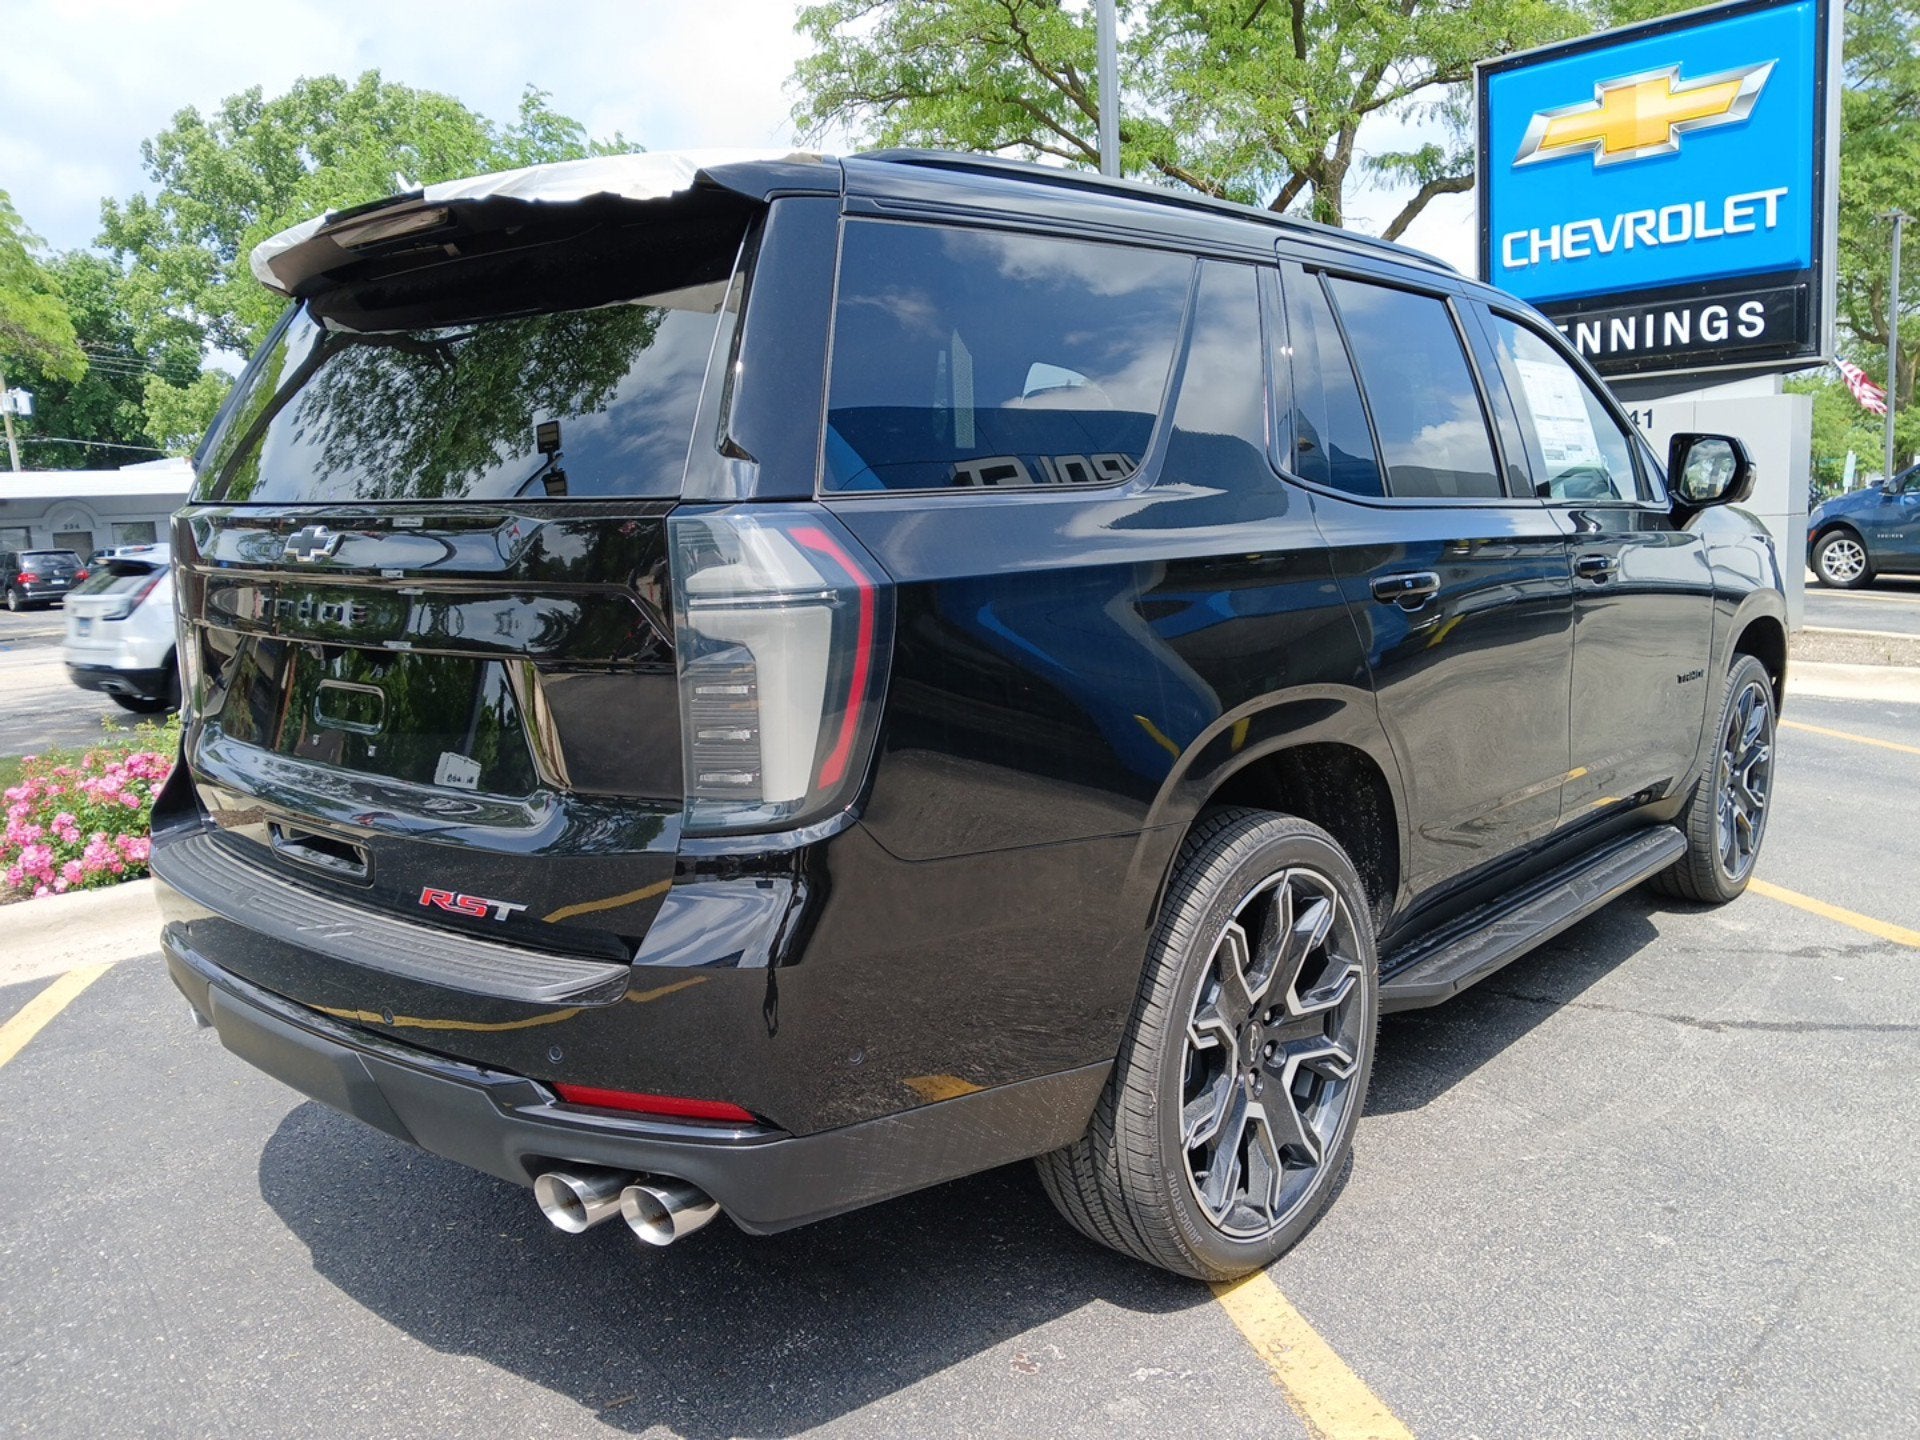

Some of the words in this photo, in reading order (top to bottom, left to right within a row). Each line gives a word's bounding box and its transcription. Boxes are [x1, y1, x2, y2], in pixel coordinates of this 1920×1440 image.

[1502, 186, 1789, 268] CHEVROLET
[1558, 301, 1765, 354] NNINGS
[419, 886, 530, 922] RST
